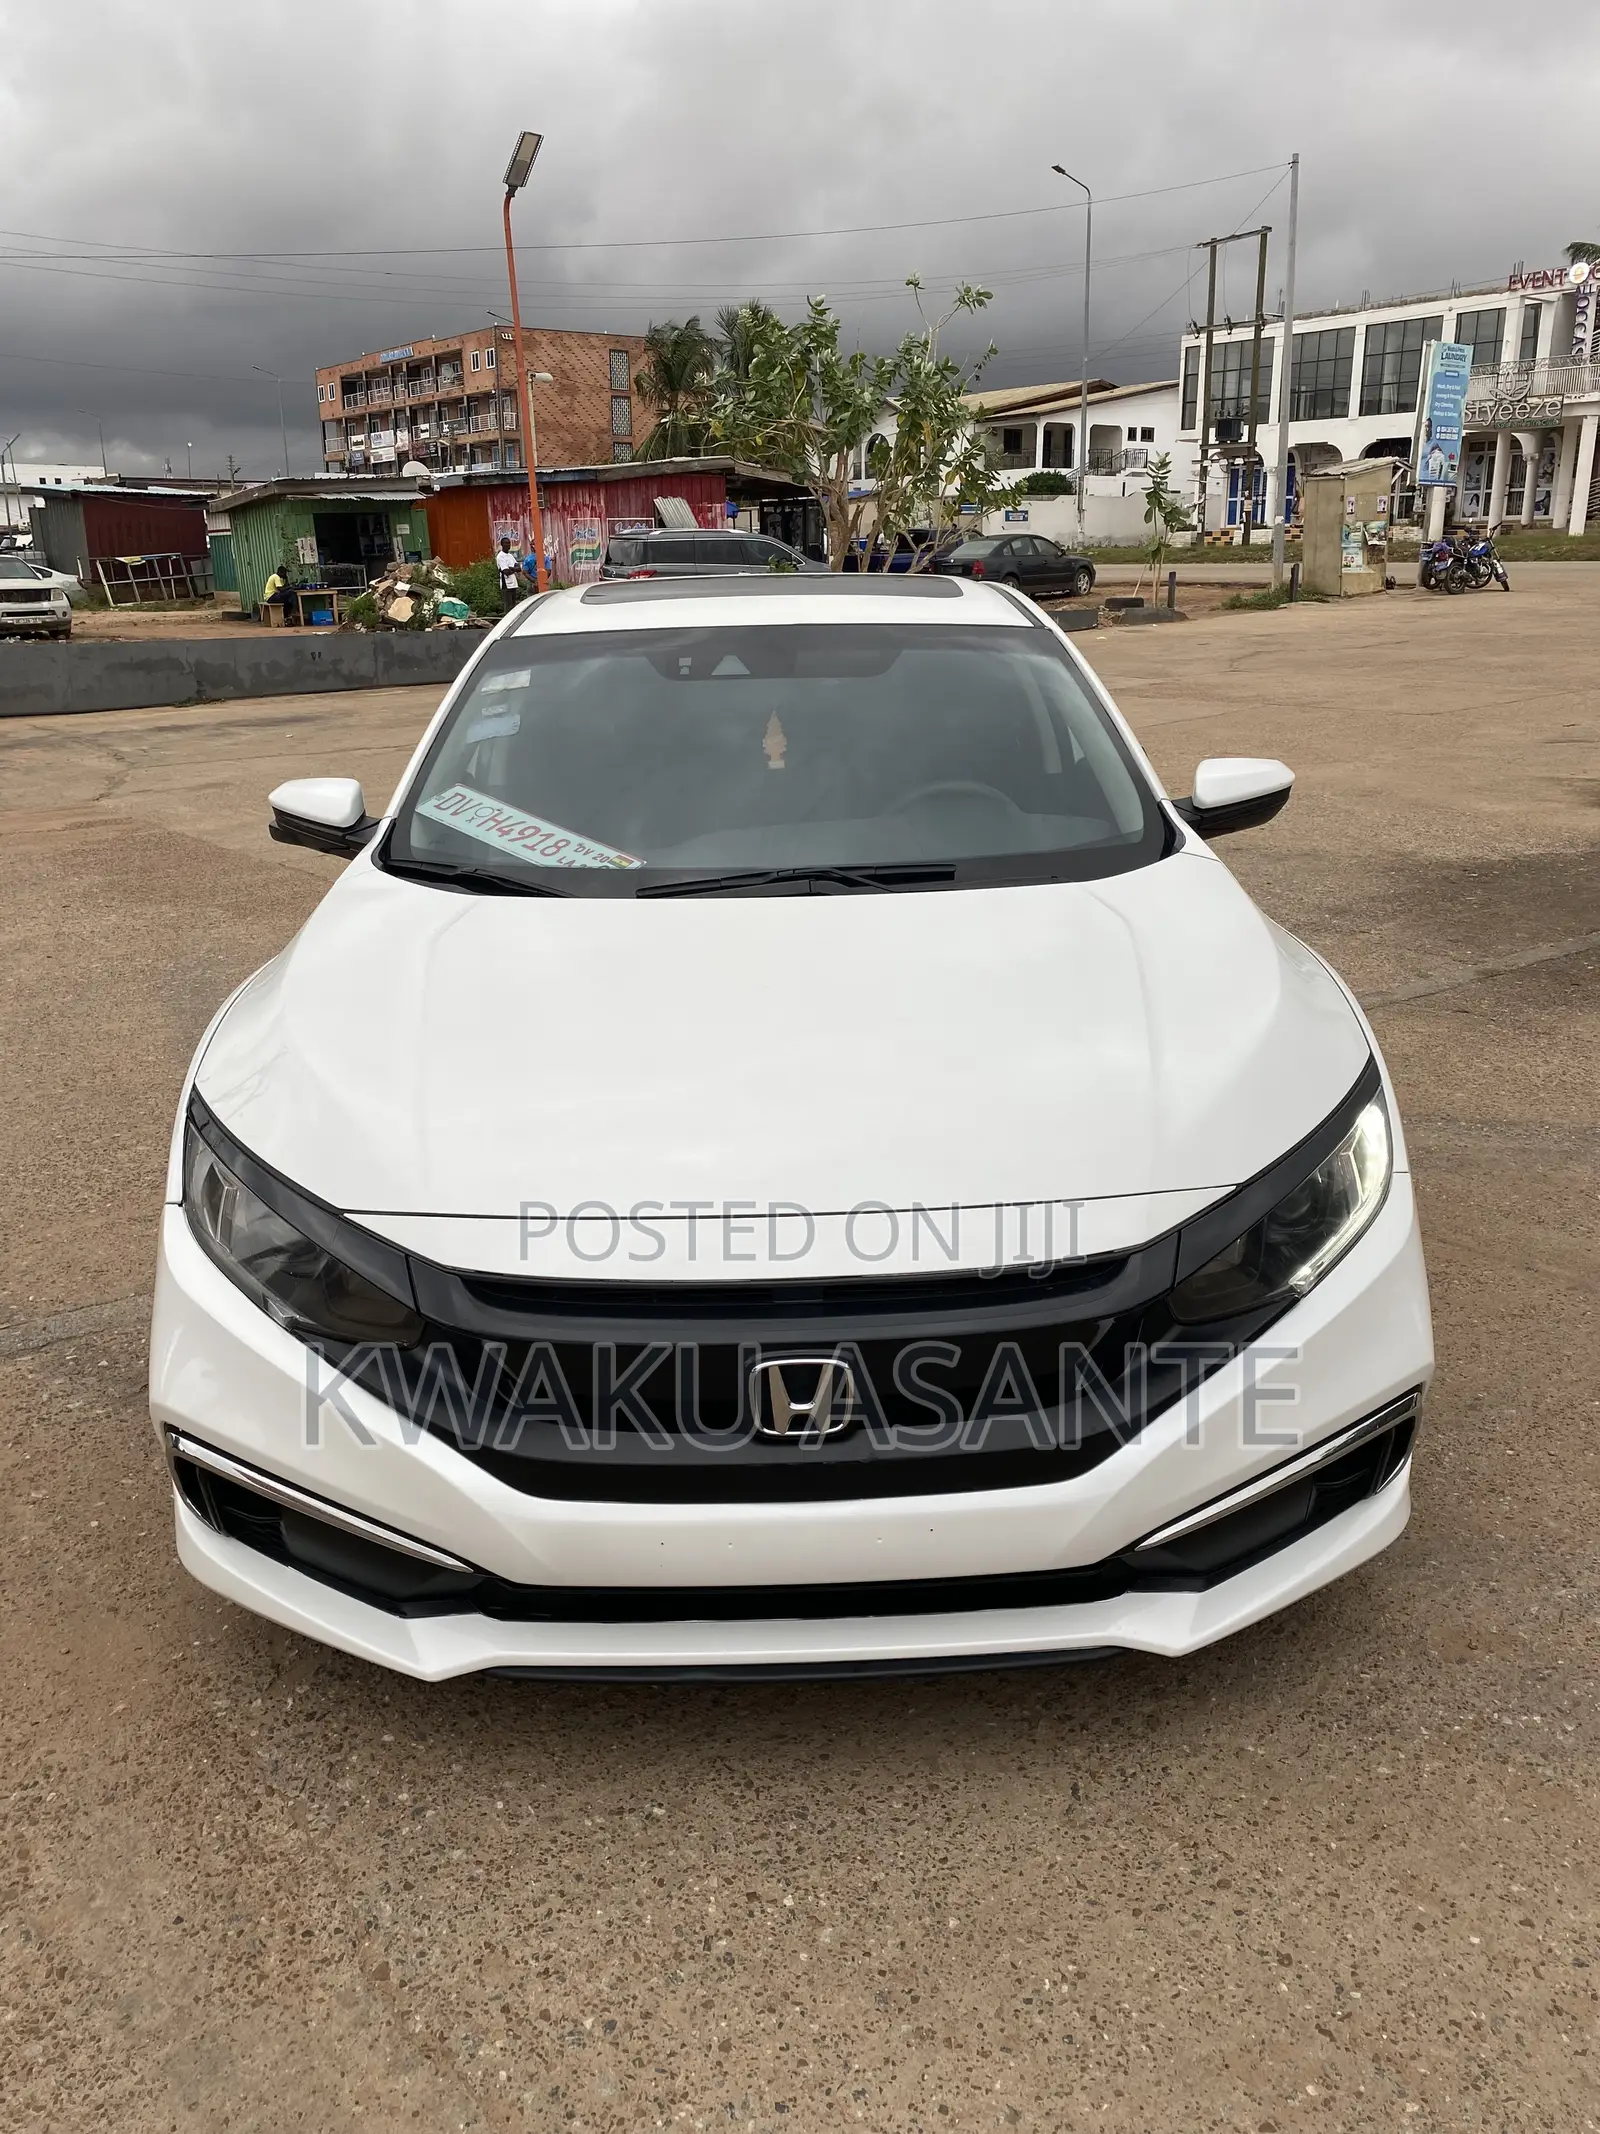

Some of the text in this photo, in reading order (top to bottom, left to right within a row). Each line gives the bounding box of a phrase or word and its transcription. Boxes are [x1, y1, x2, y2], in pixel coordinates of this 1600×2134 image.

[1508, 267, 1568, 291] EVENT
[1440, 352, 1467, 362] LAUNDRY
[434, 792, 571, 858] DV H4918
[592, 853, 611, 863] 20
